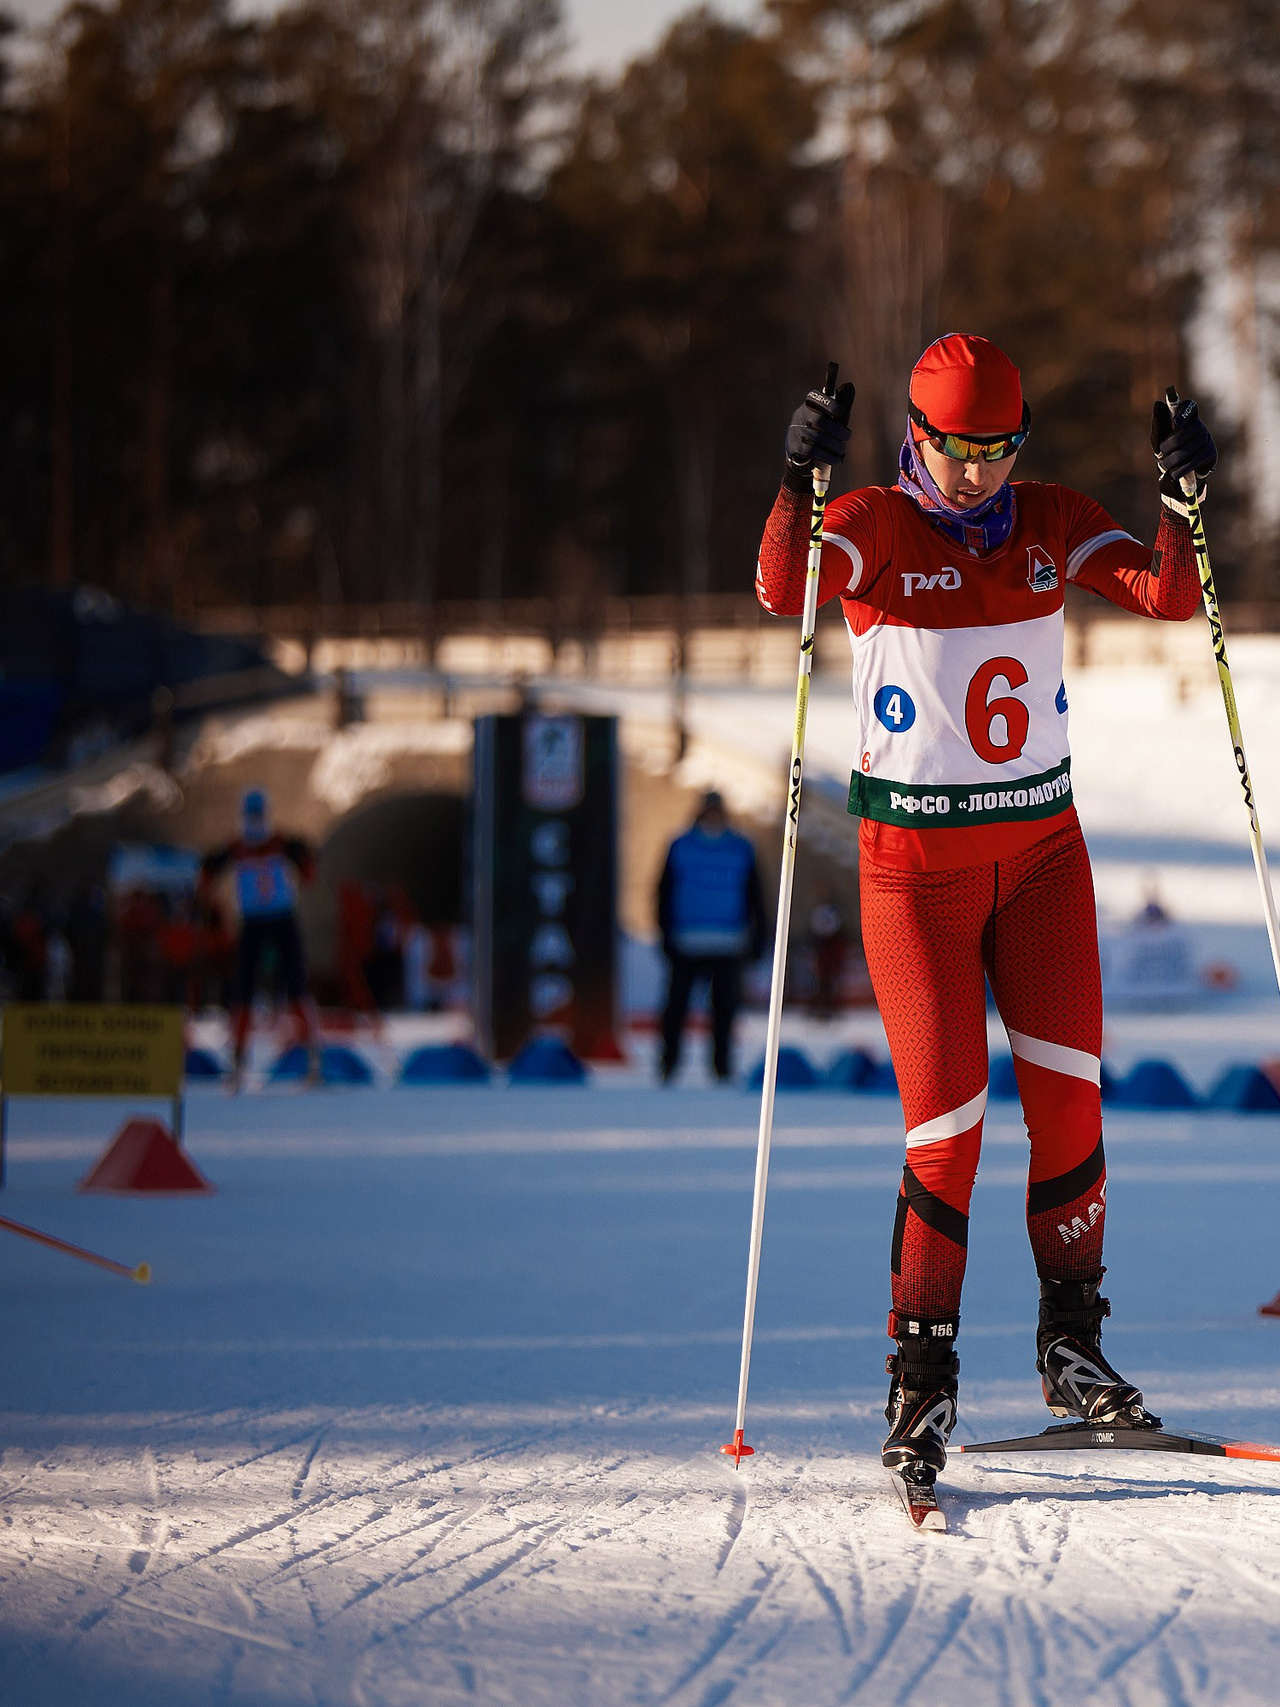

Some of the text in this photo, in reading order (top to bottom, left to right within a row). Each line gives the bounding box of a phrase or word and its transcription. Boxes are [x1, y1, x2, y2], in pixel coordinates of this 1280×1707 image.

[886, 693, 904, 725] 4
[965, 656, 1029, 765] 6
[861, 751, 872, 773] 6
[890, 791, 950, 814] РФСО
[930, 1323, 954, 1337] 156
[1091, 1432, 1115, 1443] ATOMIC
